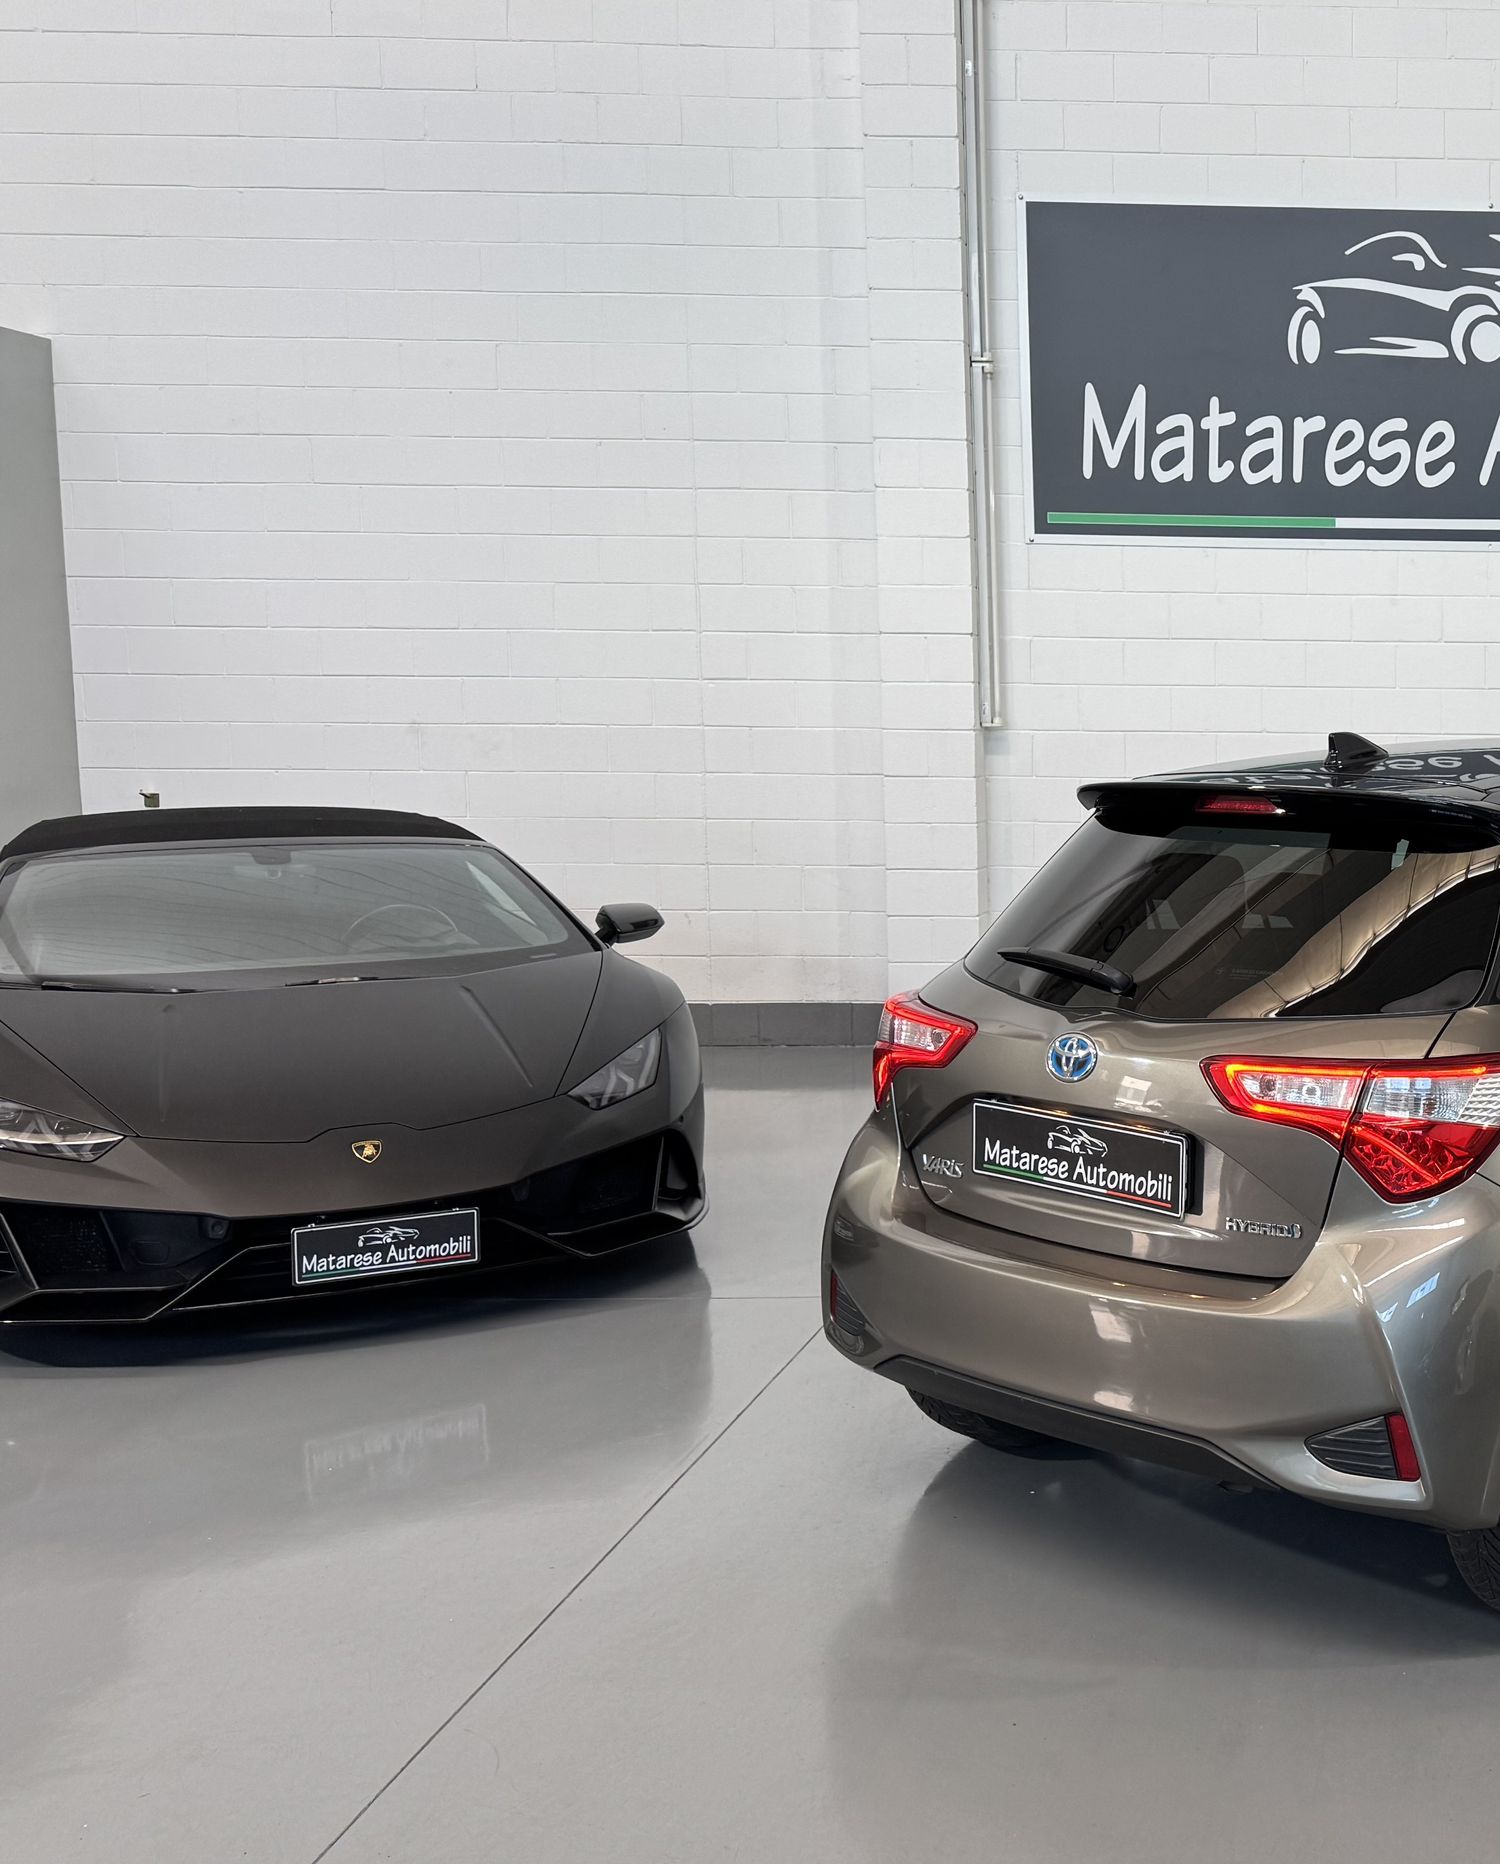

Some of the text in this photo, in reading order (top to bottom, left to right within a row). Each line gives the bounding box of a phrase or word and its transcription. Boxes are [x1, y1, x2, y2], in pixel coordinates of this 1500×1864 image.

[1082, 382, 1456, 488] Matarese
[984, 1137, 1173, 1202] Matarese Automobili
[1225, 1216, 1291, 1237] HYBRID
[302, 1235, 471, 1274] Matarese Automobili
